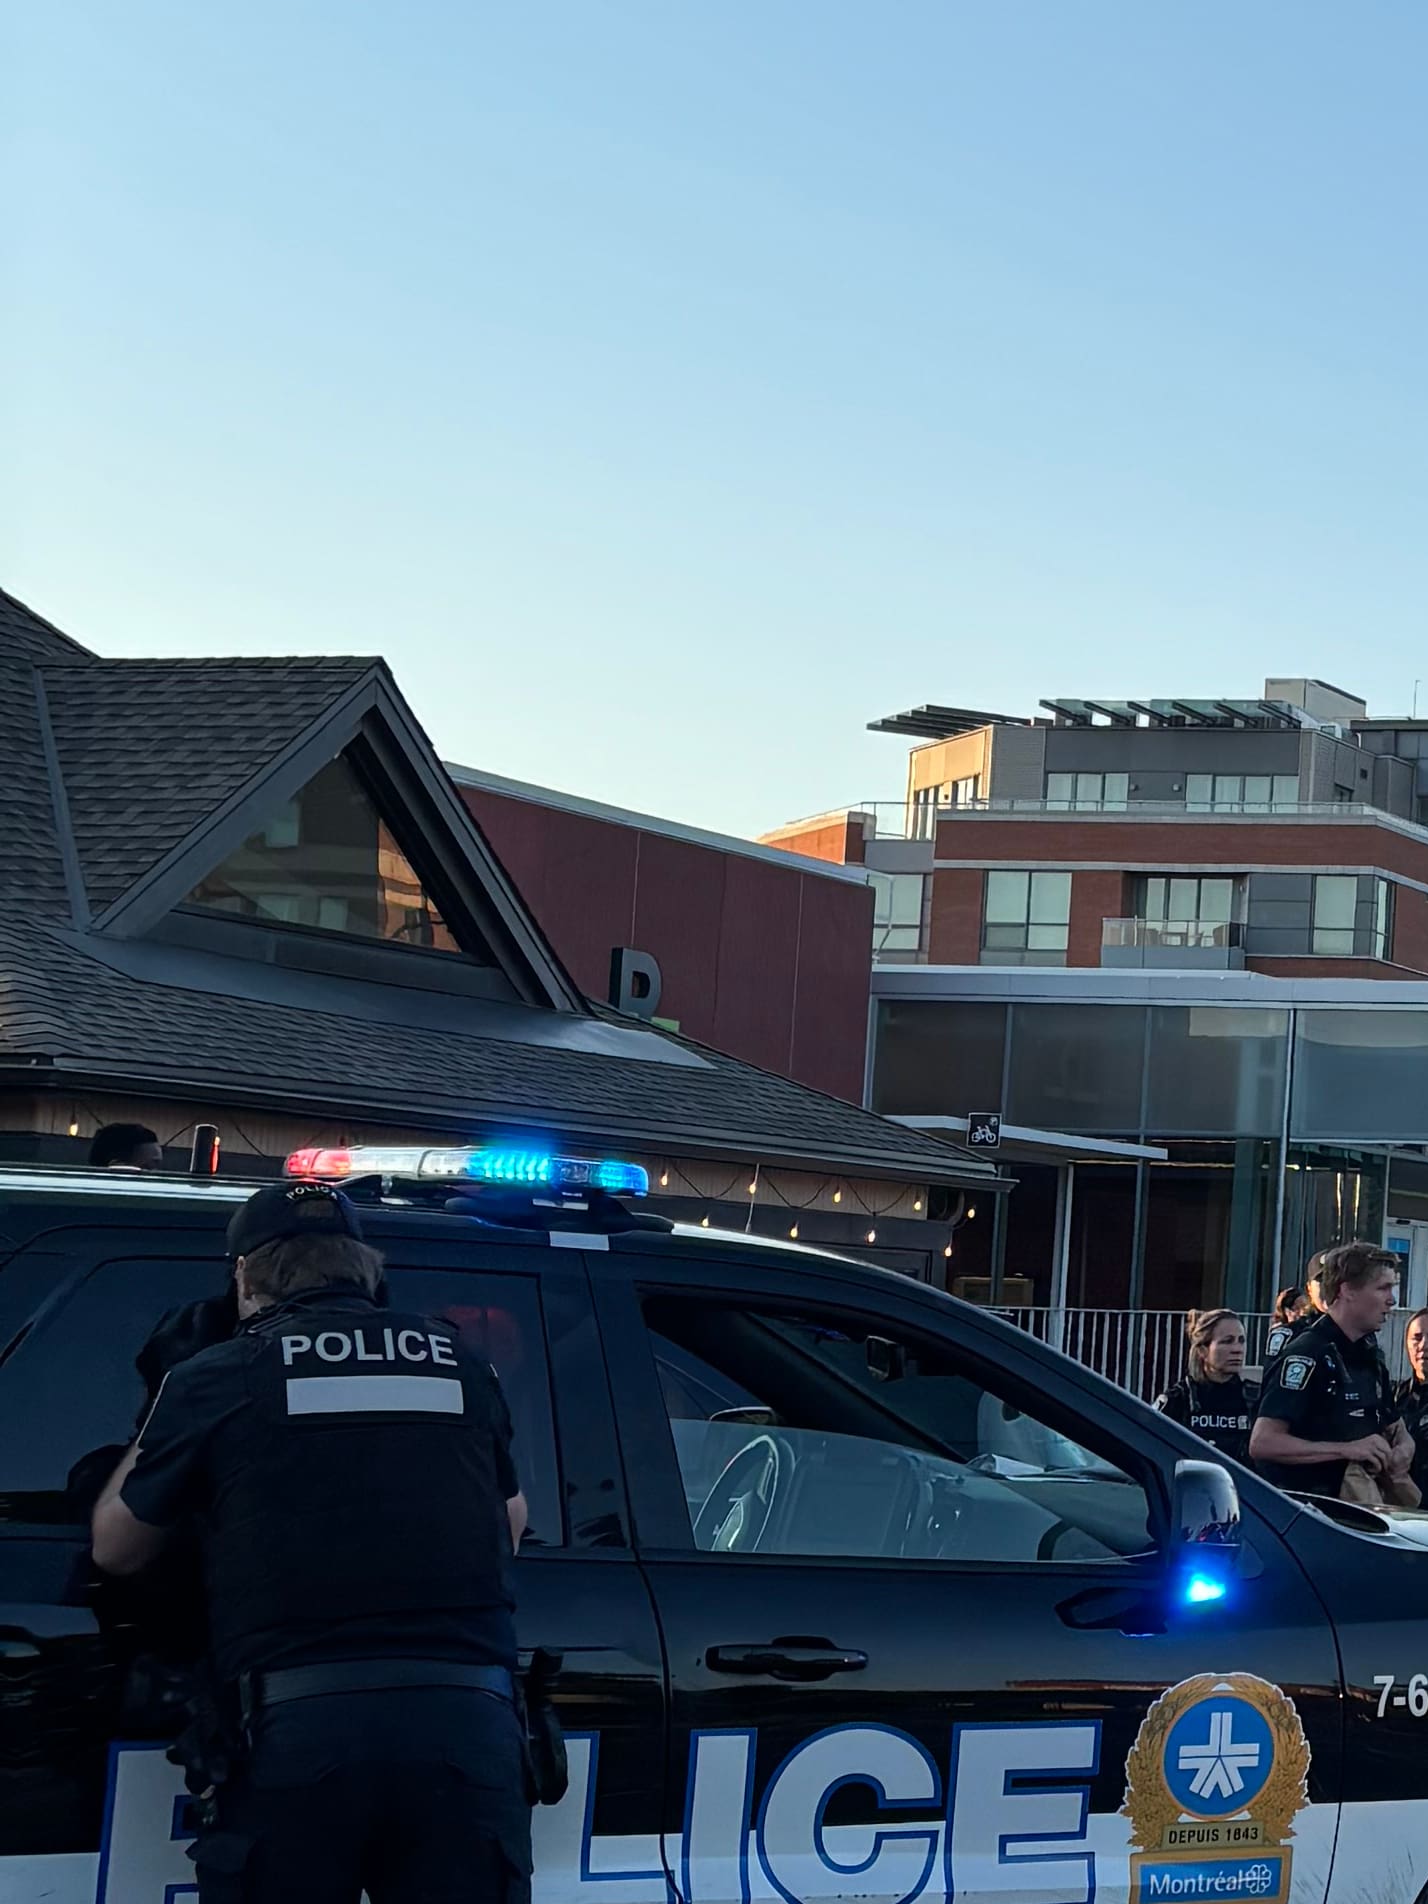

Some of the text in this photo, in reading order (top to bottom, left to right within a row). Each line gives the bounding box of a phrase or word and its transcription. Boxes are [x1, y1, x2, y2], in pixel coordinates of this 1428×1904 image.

[281, 1328, 458, 1366] POLICE
[1191, 1415, 1237, 1429] POLICE
[1168, 1826, 1259, 1845] DEPUIS 1843
[1150, 1869, 1244, 1896] Montréal
